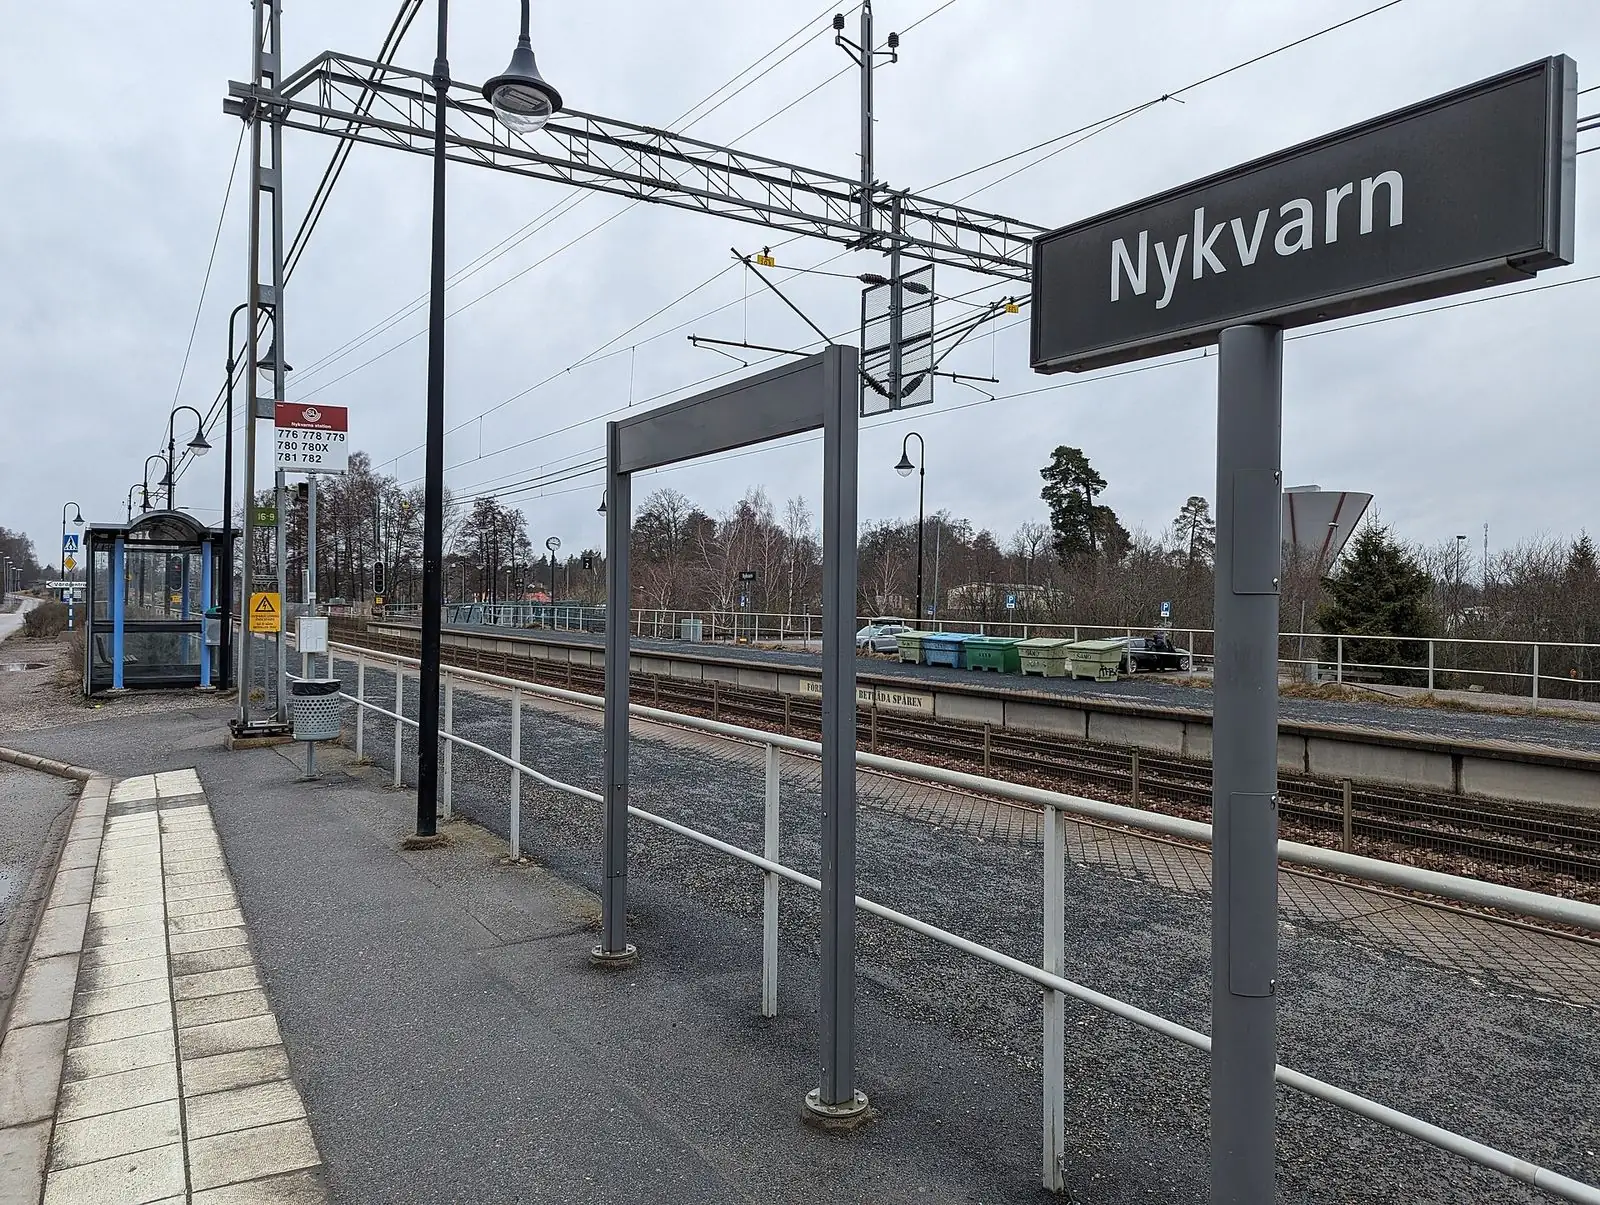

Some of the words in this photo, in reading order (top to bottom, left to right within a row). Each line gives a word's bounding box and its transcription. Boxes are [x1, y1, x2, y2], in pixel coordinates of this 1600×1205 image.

[1110, 169, 1404, 309] Nykvarn
[277, 429, 299, 439] 776
[302, 430, 323, 441] 778
[325, 432, 345, 442] 779
[277, 440, 298, 450] 780
[301, 442, 329, 452] 780X
[277, 452, 297, 462] 781
[301, 454, 322, 463] 782
[892, 693, 923, 708] SPÅREN
